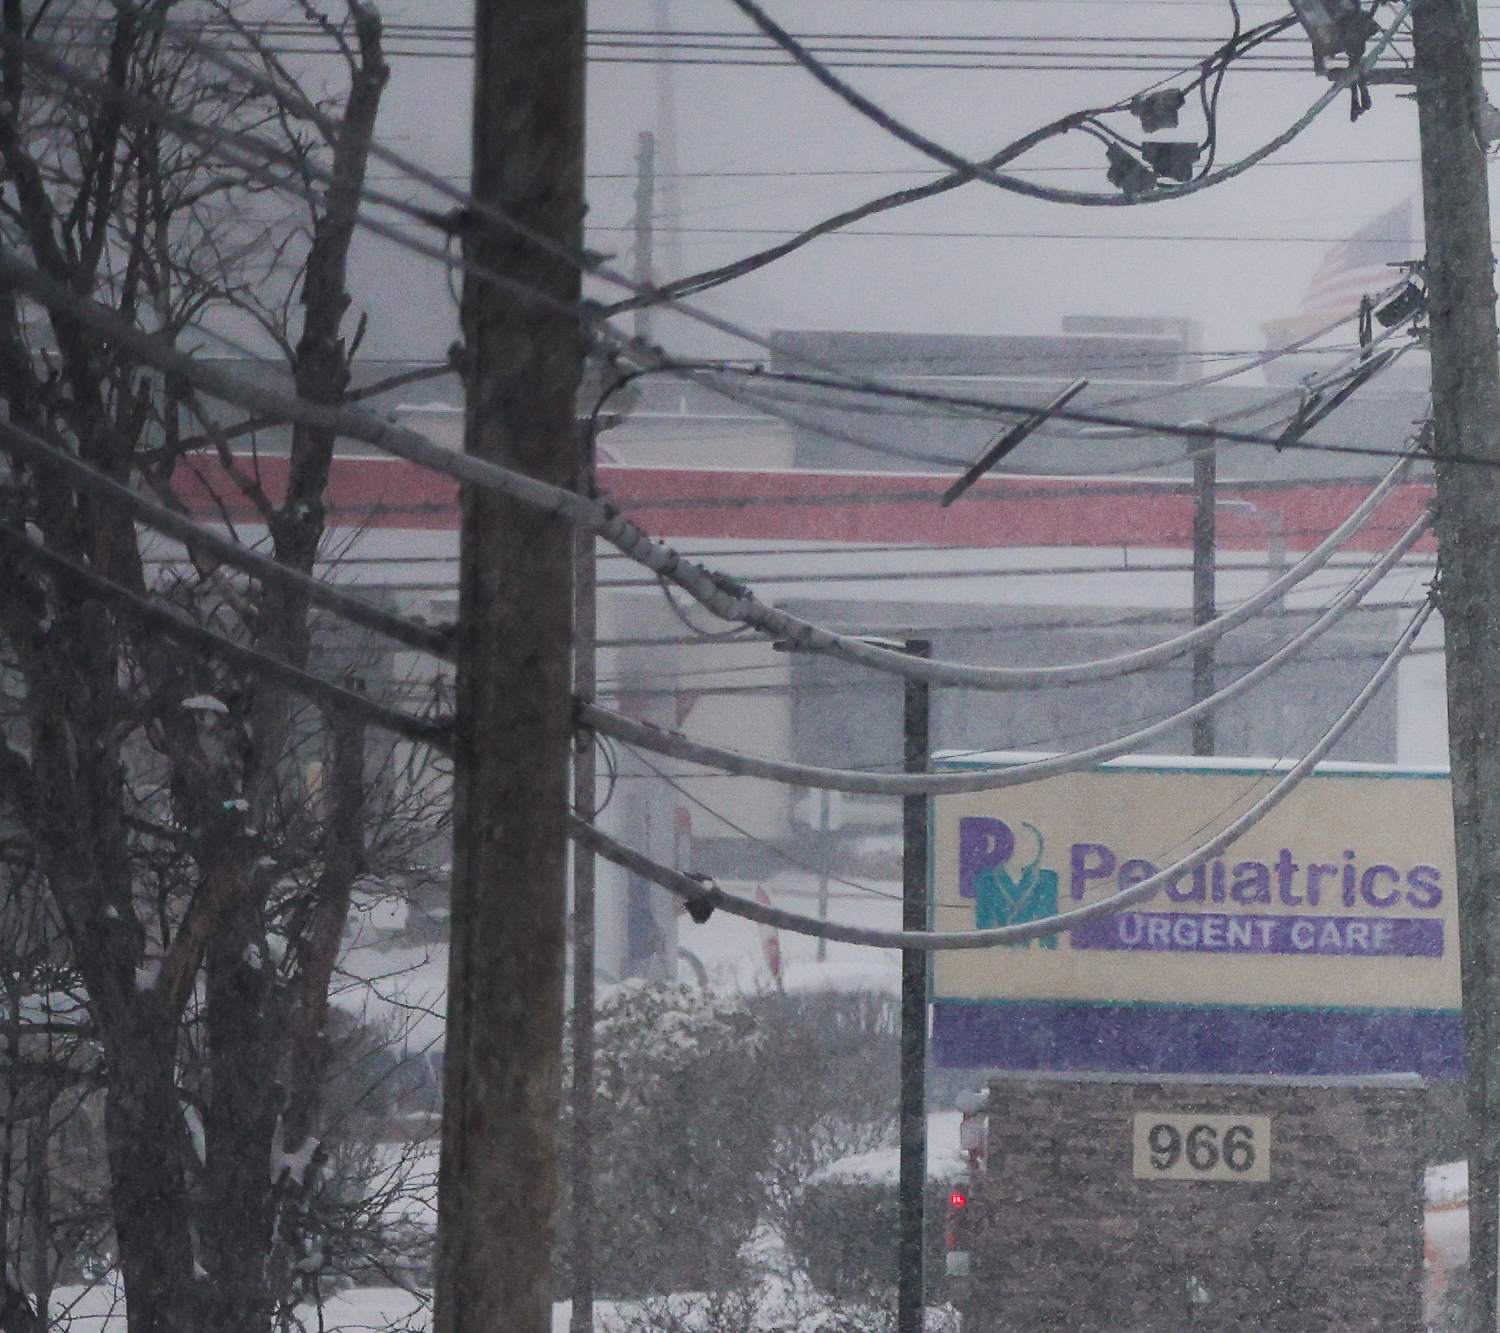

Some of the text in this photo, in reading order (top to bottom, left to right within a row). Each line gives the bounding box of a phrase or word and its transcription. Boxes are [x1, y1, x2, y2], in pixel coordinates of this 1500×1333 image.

[1071, 843, 1443, 909] Pediatrics
[1119, 914, 1278, 948] URGENT
[1149, 1123, 1256, 1172] 966
